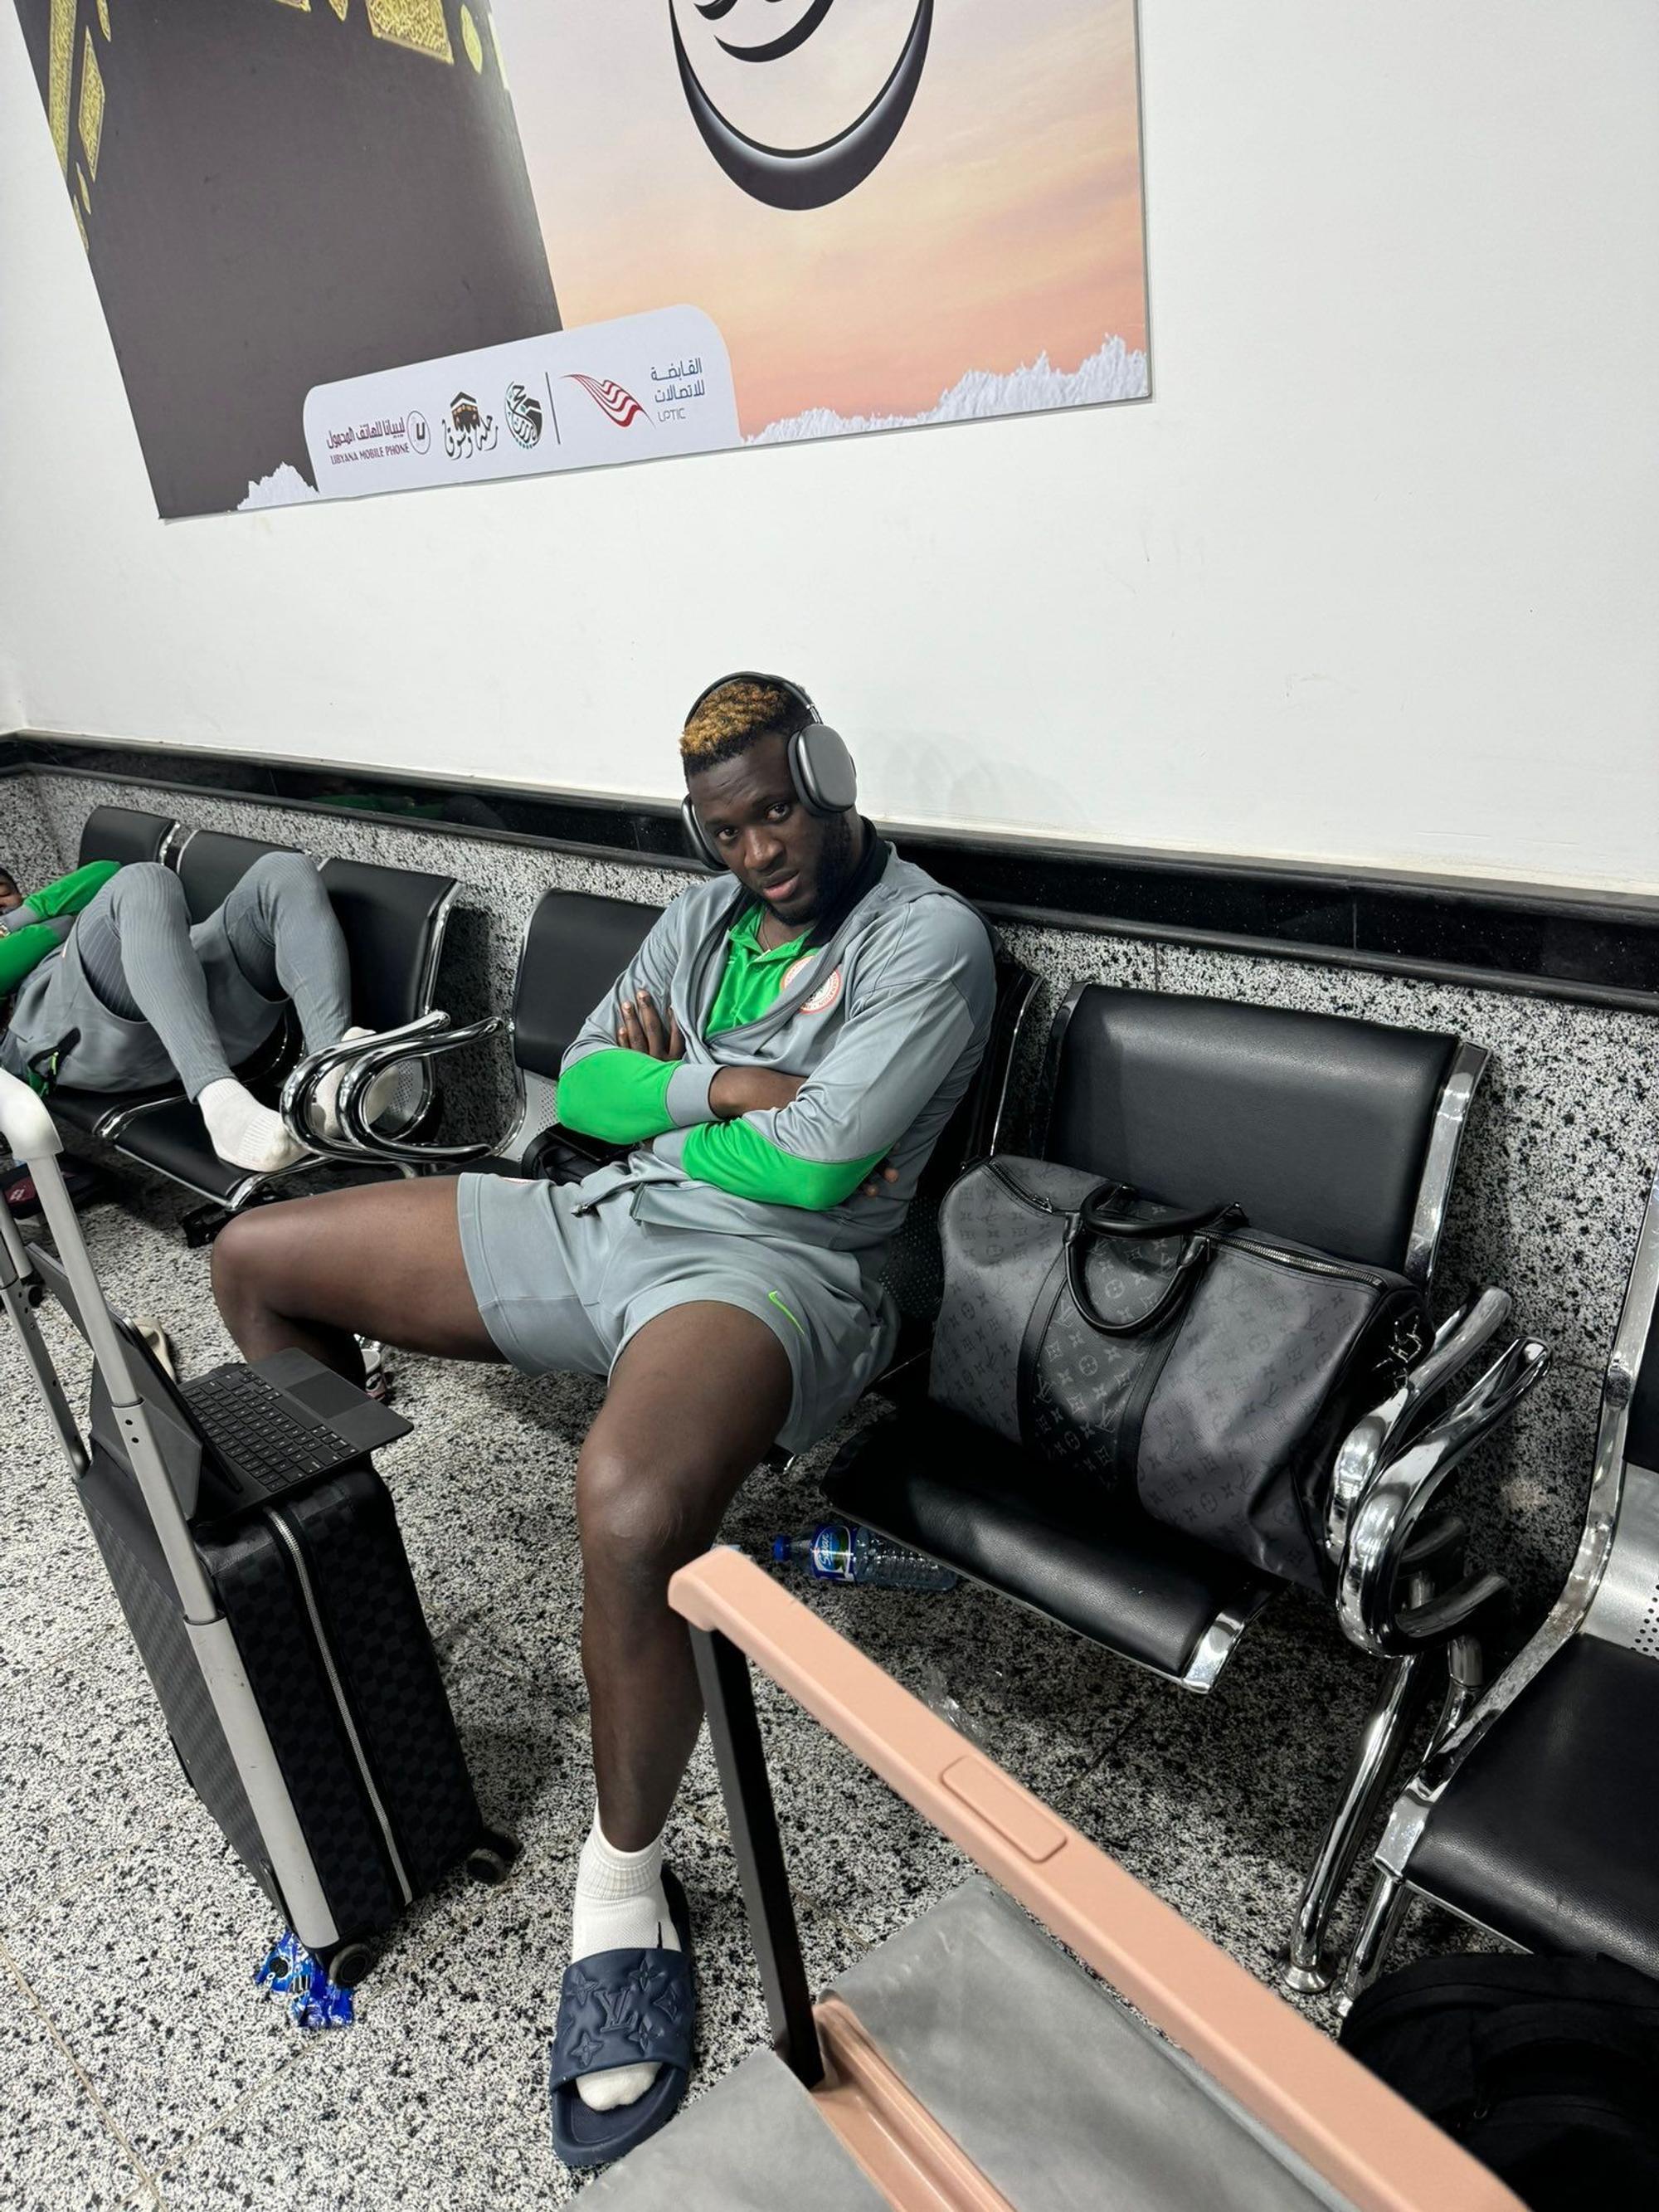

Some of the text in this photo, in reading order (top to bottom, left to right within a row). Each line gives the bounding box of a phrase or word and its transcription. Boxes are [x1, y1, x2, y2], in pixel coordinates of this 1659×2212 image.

[654, 379, 705, 402] للاتصالات
[657, 407, 686, 422] LPTIC
[356, 421, 382, 441] للهاتف
[330, 442, 410, 465] LIBYANA MOBILE PHONE
